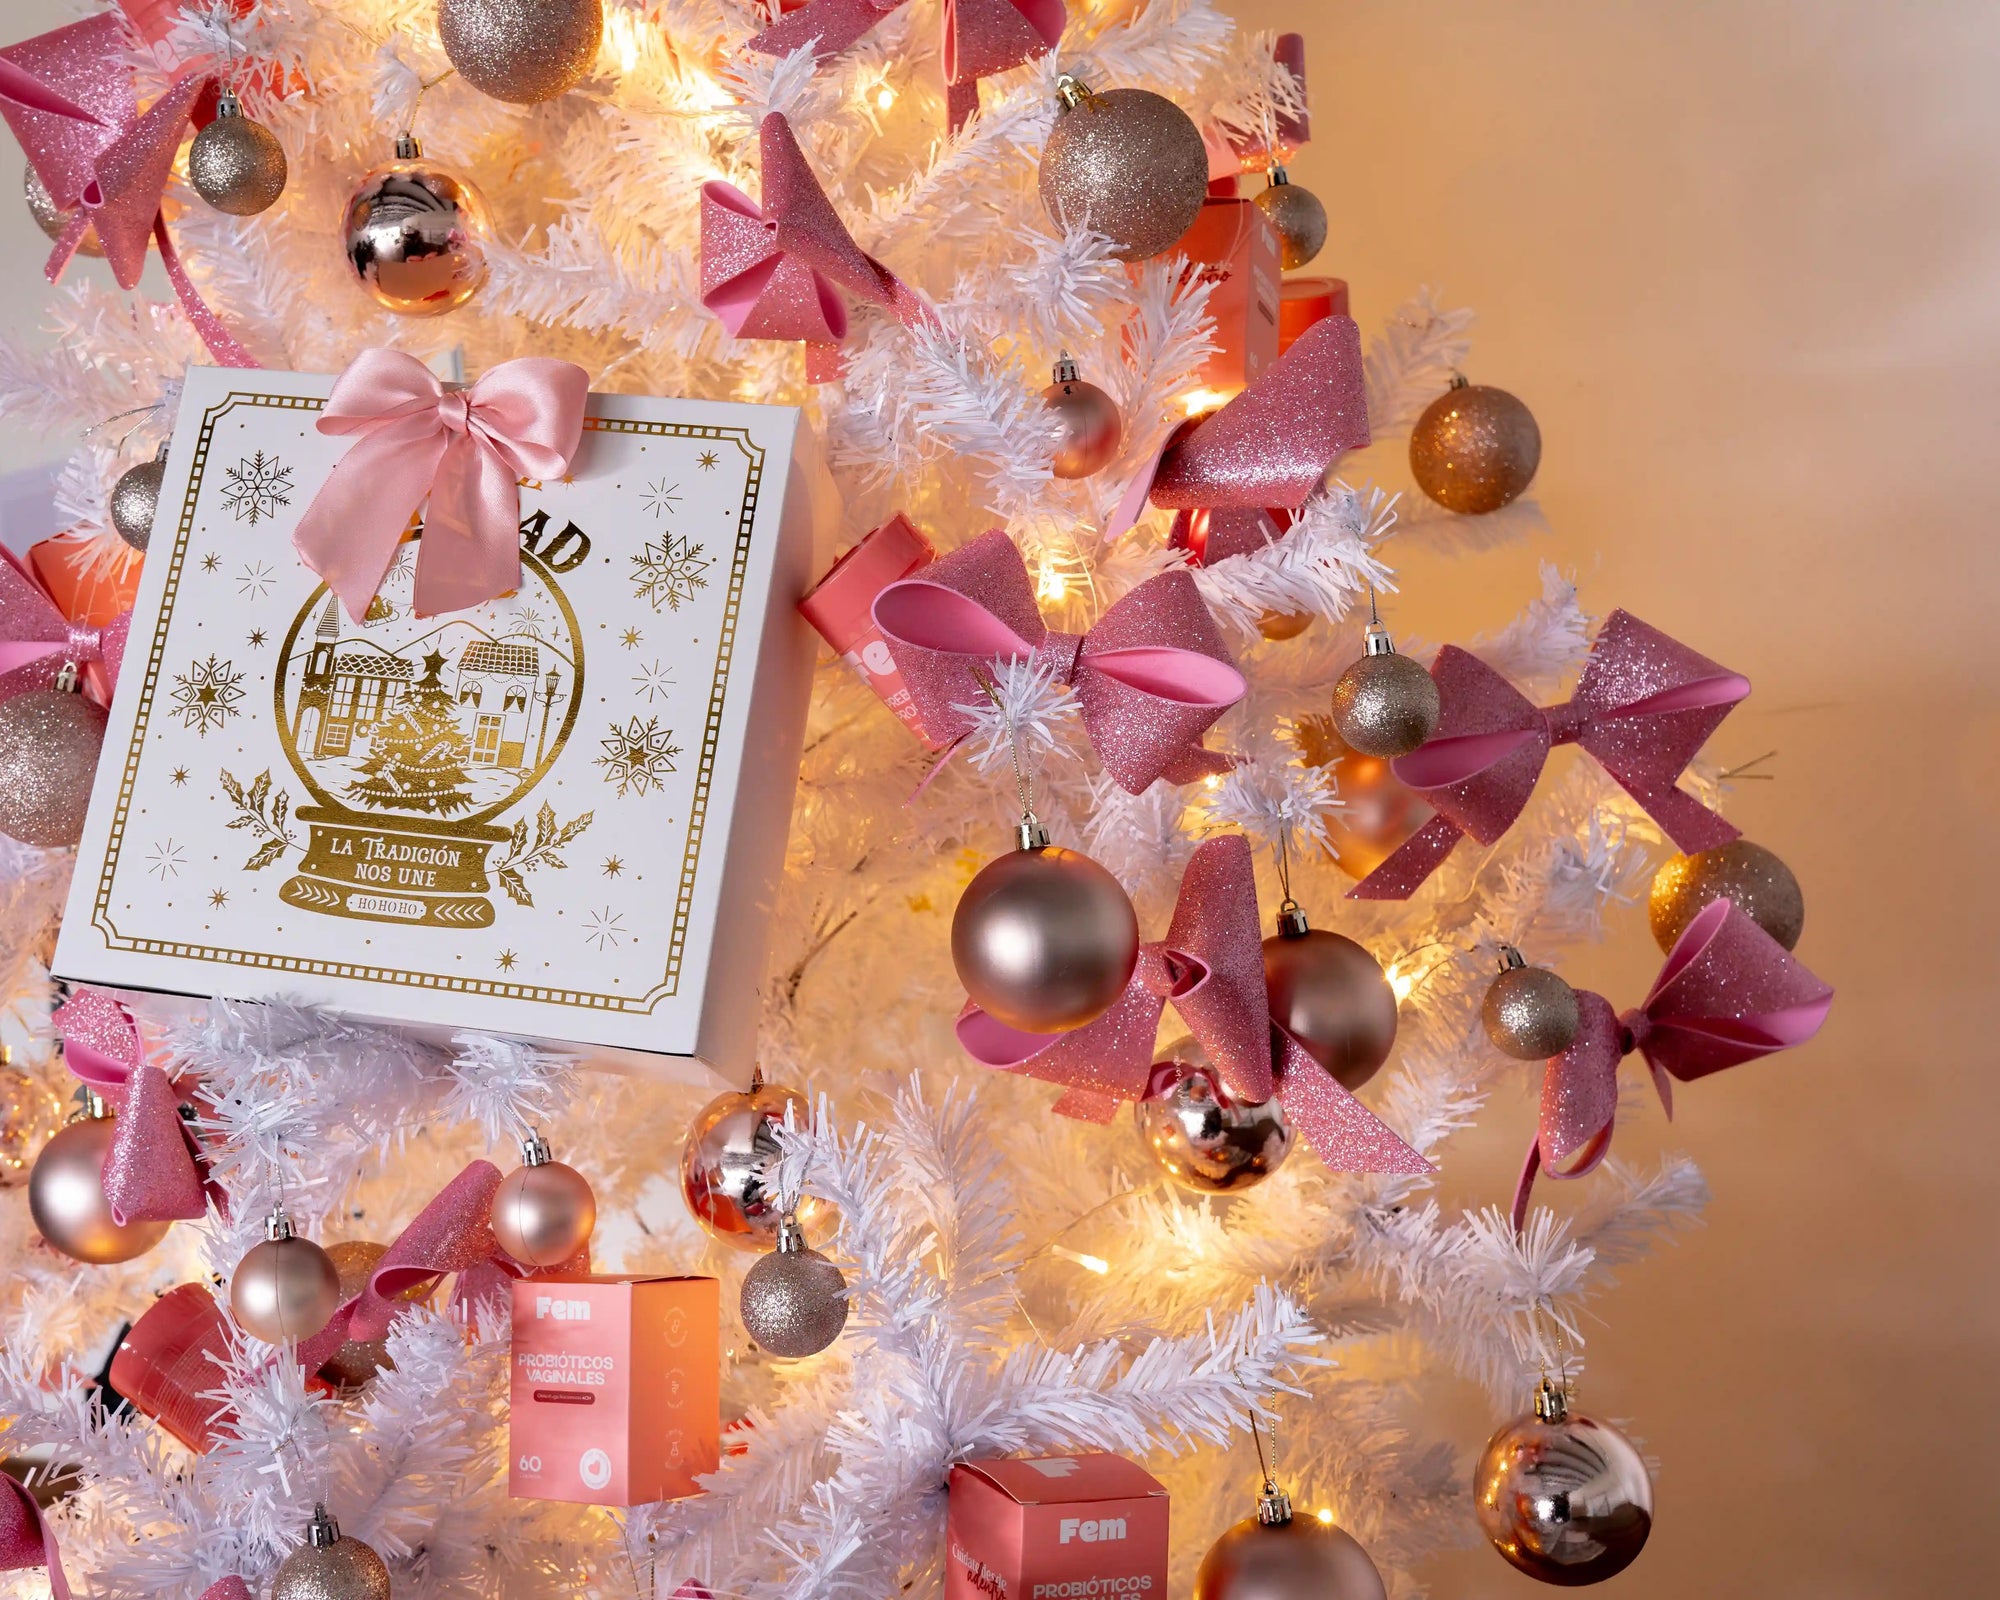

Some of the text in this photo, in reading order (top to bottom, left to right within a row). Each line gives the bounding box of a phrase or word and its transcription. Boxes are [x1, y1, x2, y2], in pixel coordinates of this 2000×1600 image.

[330, 836, 461, 867] LA TRADICIÓN
[354, 863, 437, 888] NOS UNE
[536, 1296, 591, 1320] Fem
[518, 1350, 614, 1370] PROBIÓTICOS
[526, 1369, 606, 1385] VAGINALES
[519, 1455, 542, 1472] 60
[1059, 1517, 1127, 1544] Fem
[1033, 1575, 1153, 1599] PROBIÓTICOS
